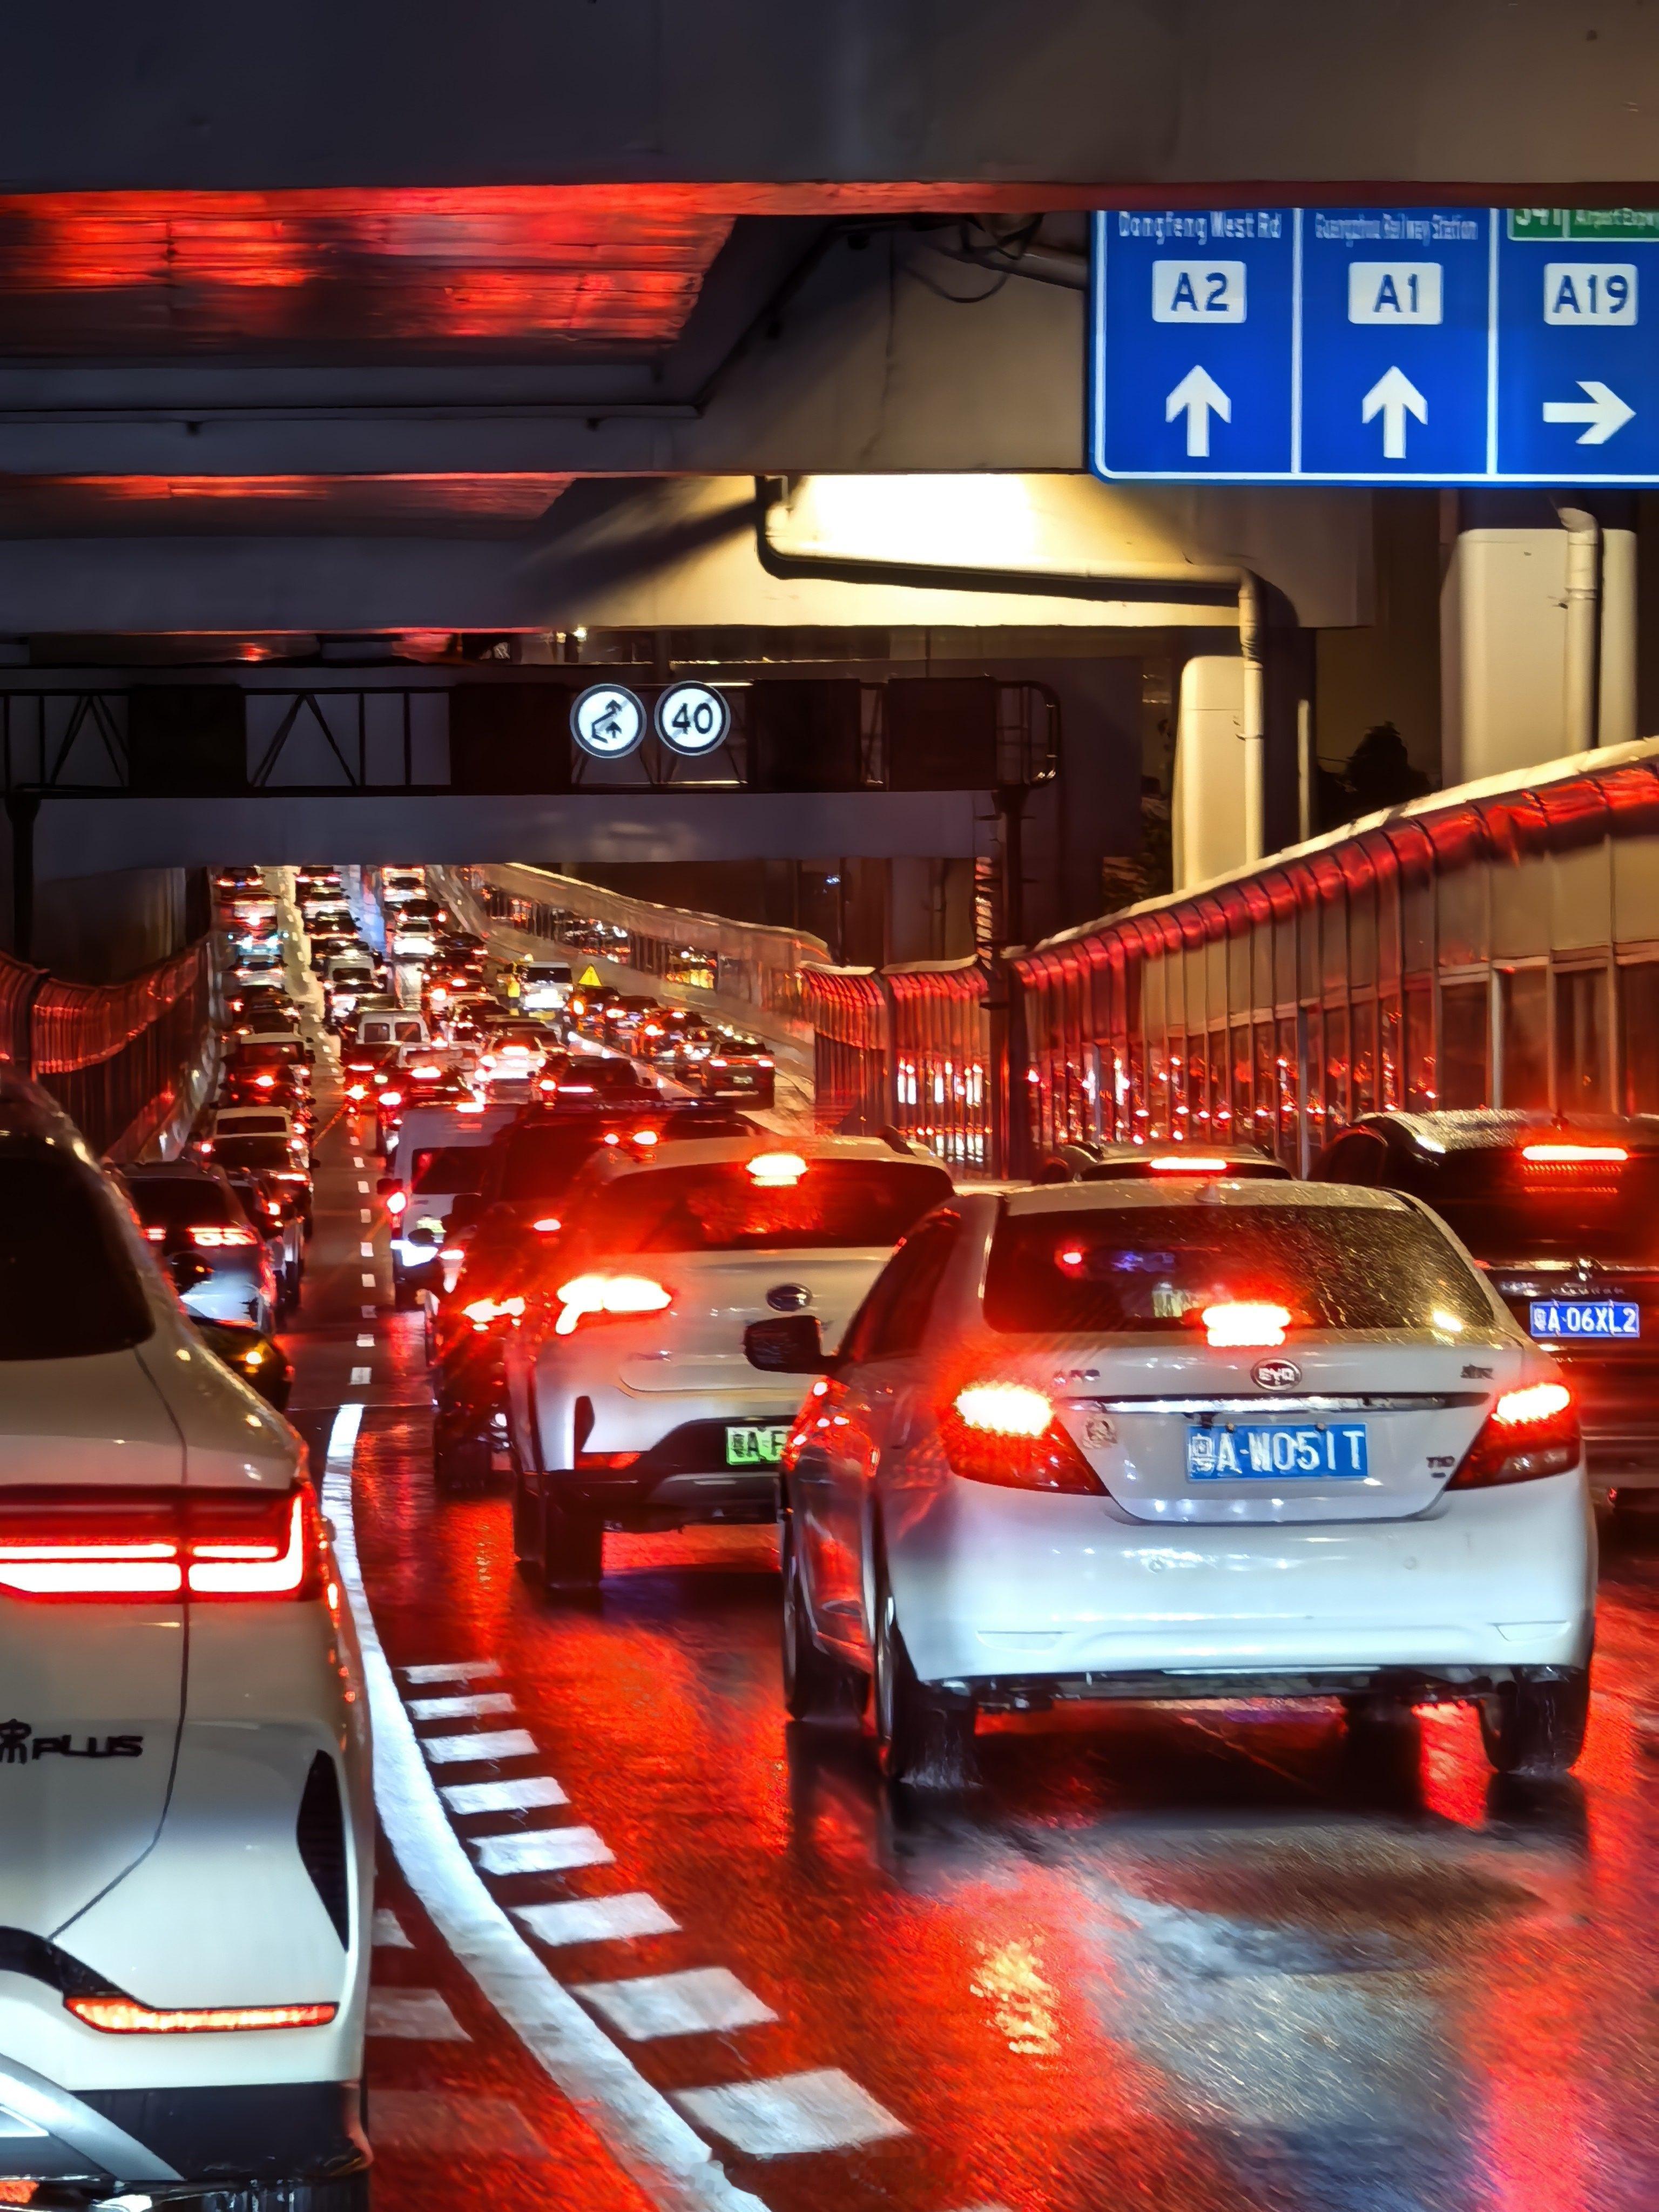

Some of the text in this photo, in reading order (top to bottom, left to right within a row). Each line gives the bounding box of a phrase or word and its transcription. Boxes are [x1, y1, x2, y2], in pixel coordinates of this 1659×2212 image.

[1210, 211, 1255, 238] West
[1170, 272, 1230, 312] A2
[1373, 273, 1419, 313] A1
[1552, 274, 1629, 314] A19
[671, 702, 714, 735] 40
[31, 1734, 144, 1760] PLUS
